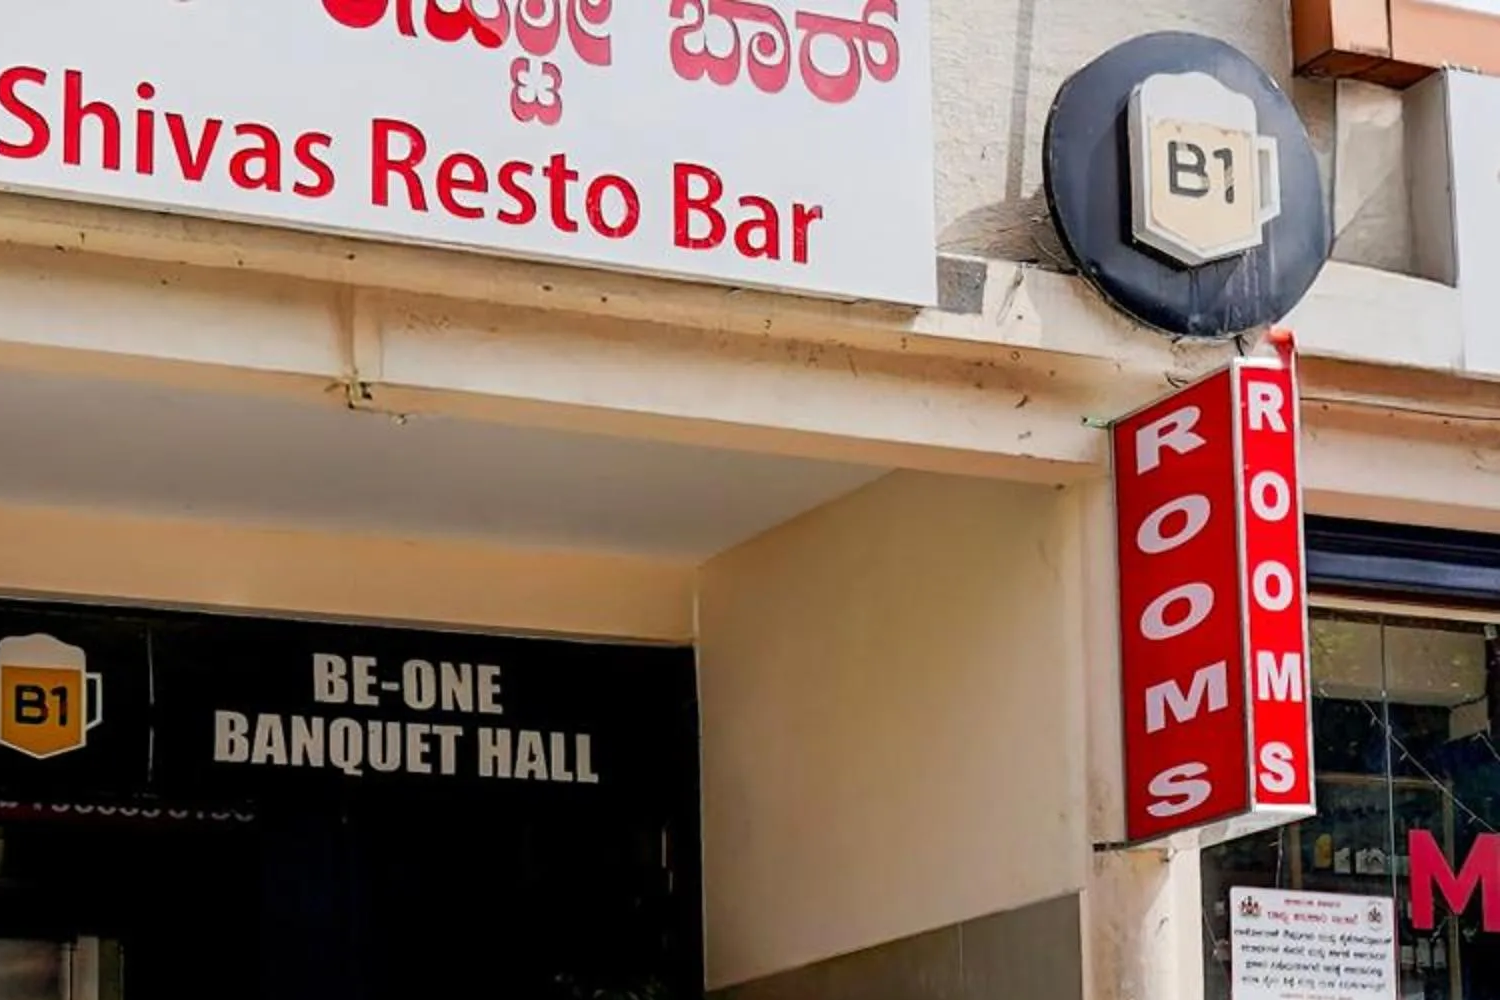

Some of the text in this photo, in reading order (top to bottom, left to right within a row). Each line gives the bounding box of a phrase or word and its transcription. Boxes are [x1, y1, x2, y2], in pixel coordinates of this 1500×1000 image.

[371, 118, 640, 238] Resto
[673, 162, 823, 265] Bar
[1167, 140, 1235, 204] B1
[1135, 405, 1229, 817] ROOMS
[1247, 381, 1303, 793] ROOMS
[15, 684, 68, 728] B1
[312, 653, 503, 714] BE-ONE
[214, 709, 599, 783] BANQUET HALL
